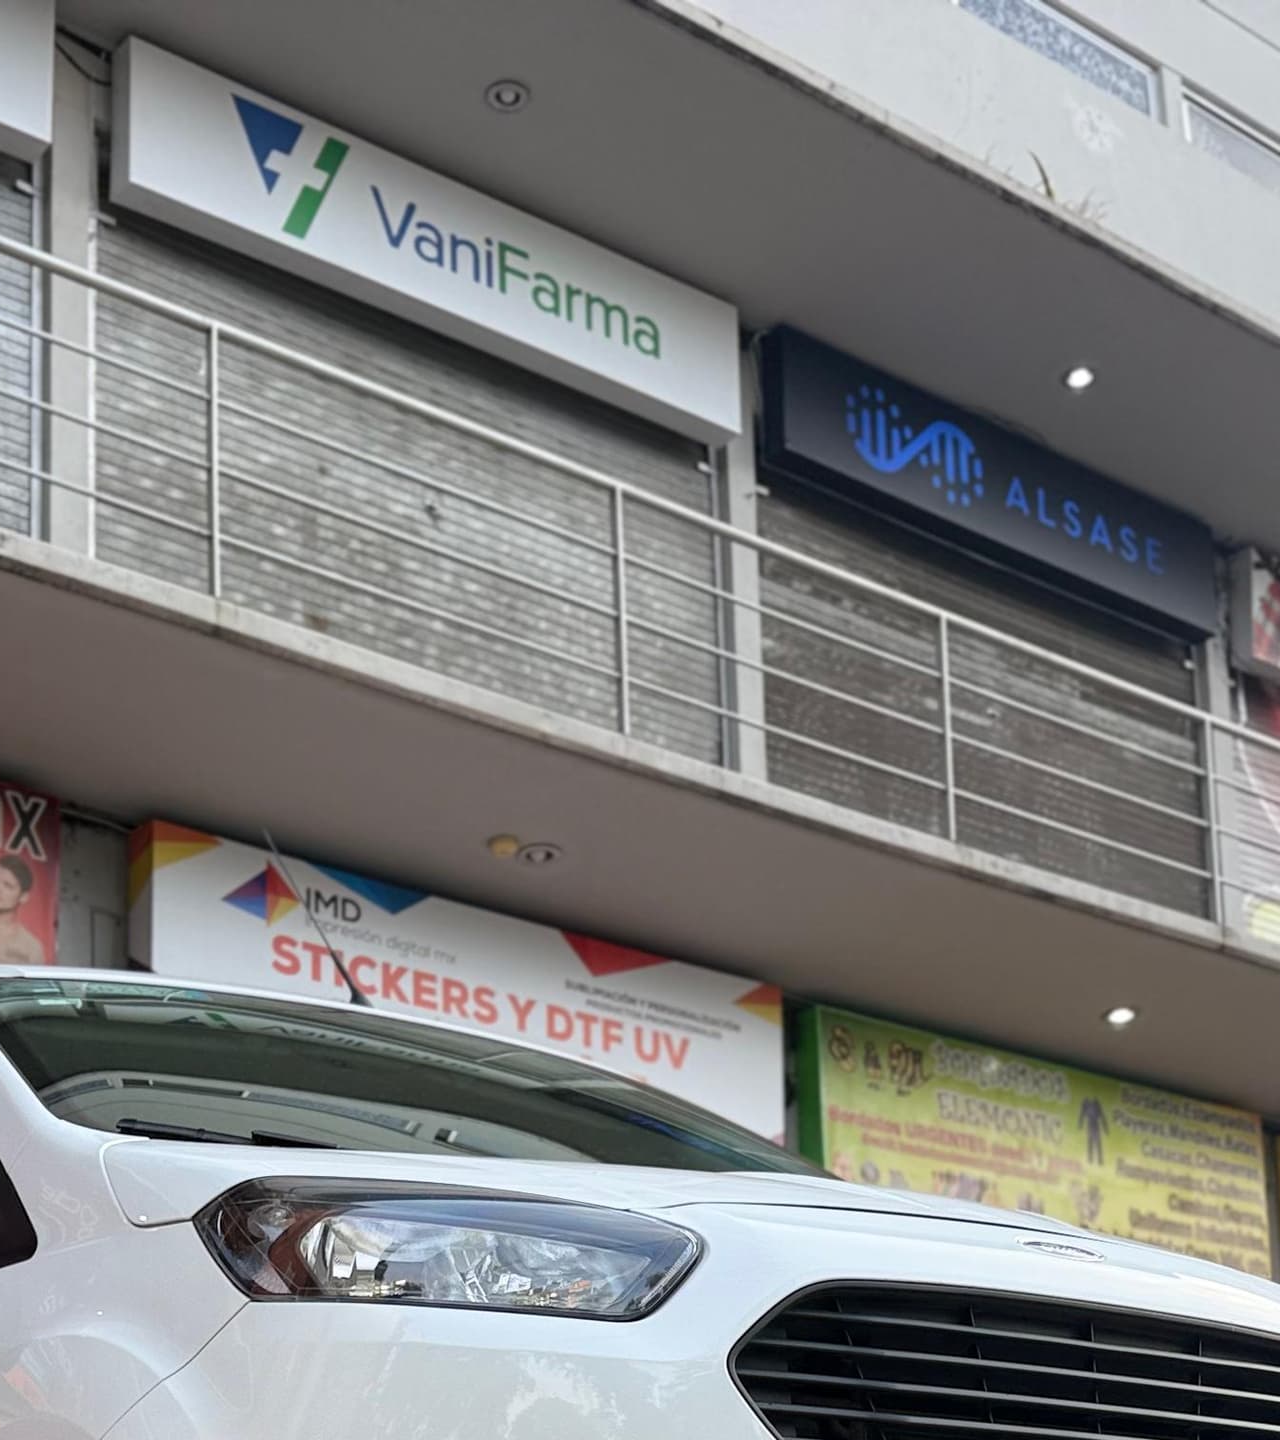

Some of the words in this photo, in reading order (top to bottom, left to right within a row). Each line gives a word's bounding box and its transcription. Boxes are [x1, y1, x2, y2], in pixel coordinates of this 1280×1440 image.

[369, 184, 662, 359] VaniFarma
[1005, 476, 1165, 575] ALSASE
[304, 887, 362, 923] IMD
[272, 934, 499, 1025] STICKERS
[507, 993, 537, 1033] Y
[546, 1004, 625, 1053] DTF
[634, 1026, 690, 1070] UV
